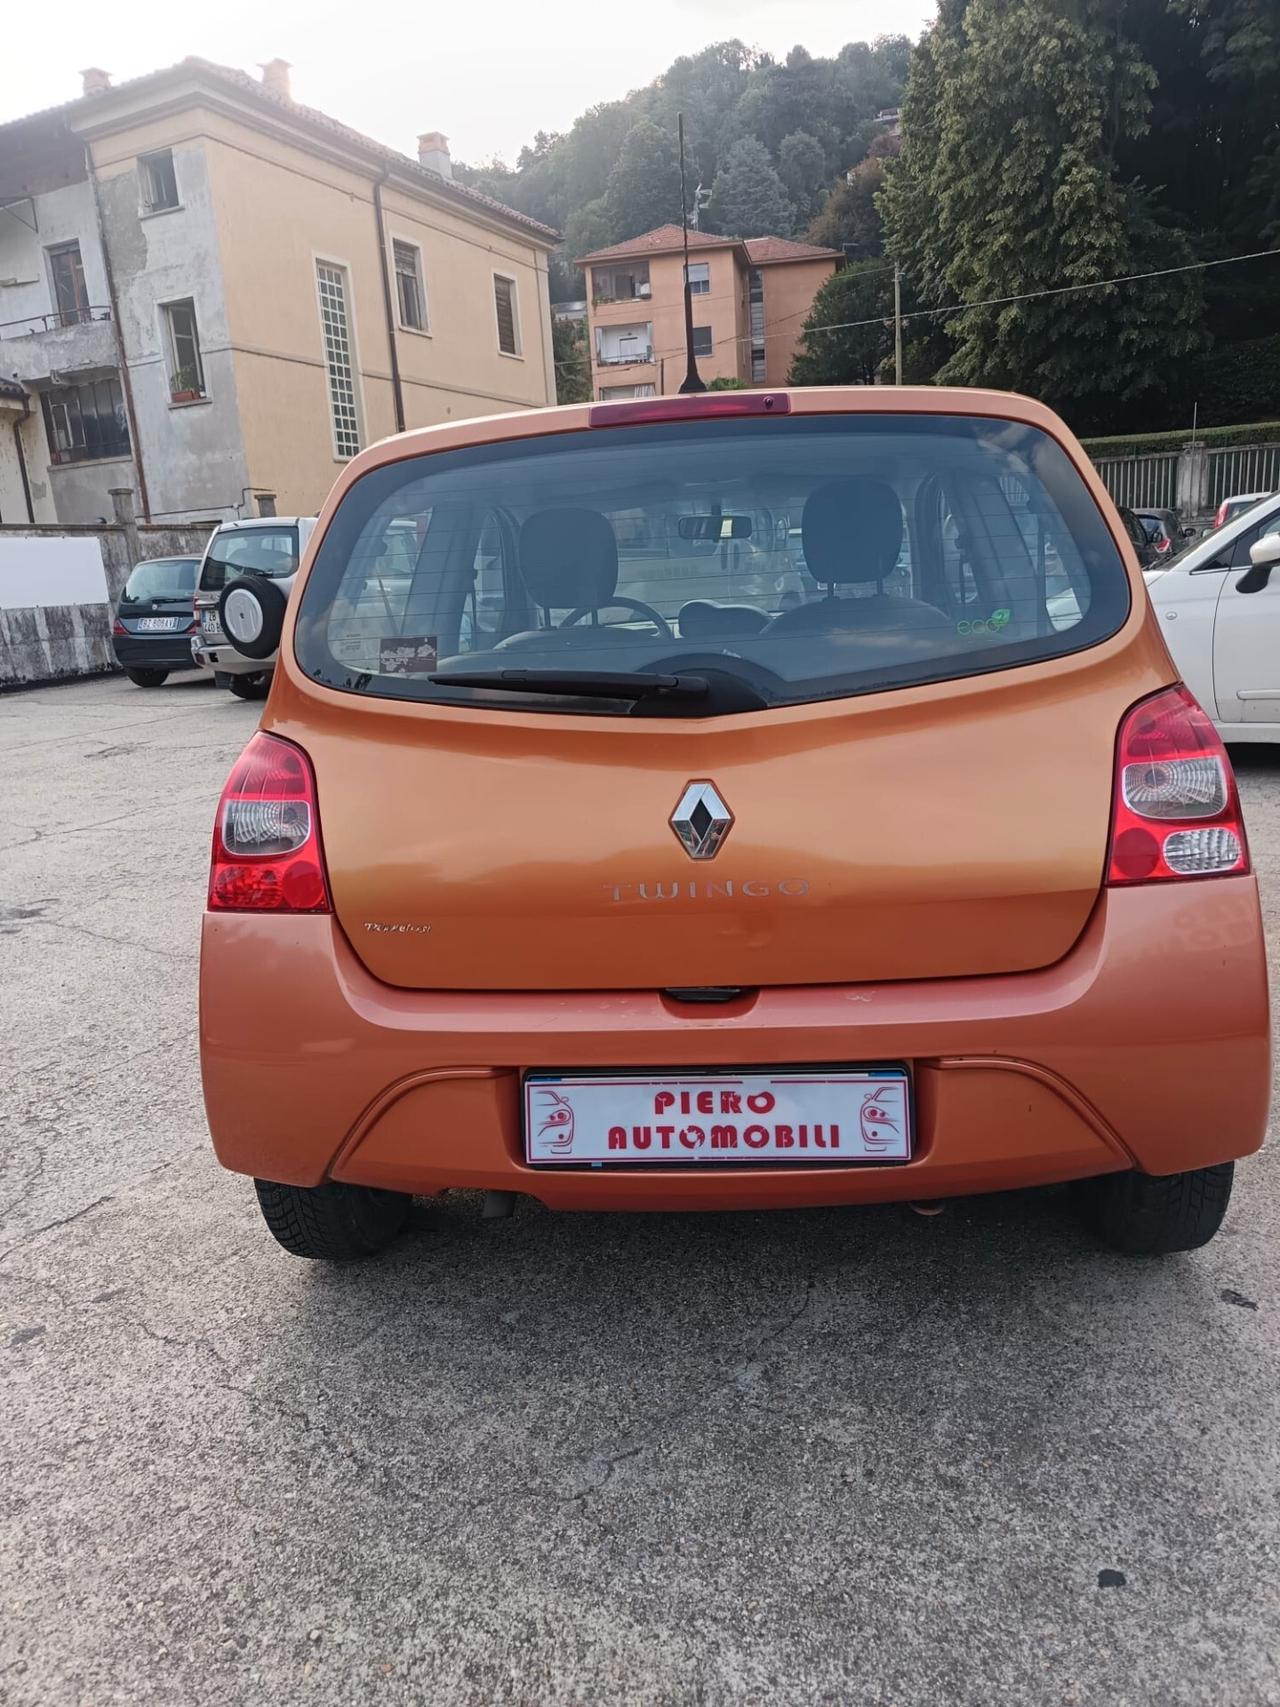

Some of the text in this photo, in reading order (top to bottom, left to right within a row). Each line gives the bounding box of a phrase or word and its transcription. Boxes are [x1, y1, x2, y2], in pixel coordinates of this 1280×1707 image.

[602, 879, 811, 902] TWINGO
[654, 1090, 776, 1115] PIERO
[607, 1124, 840, 1151] AUTOMOBILI
